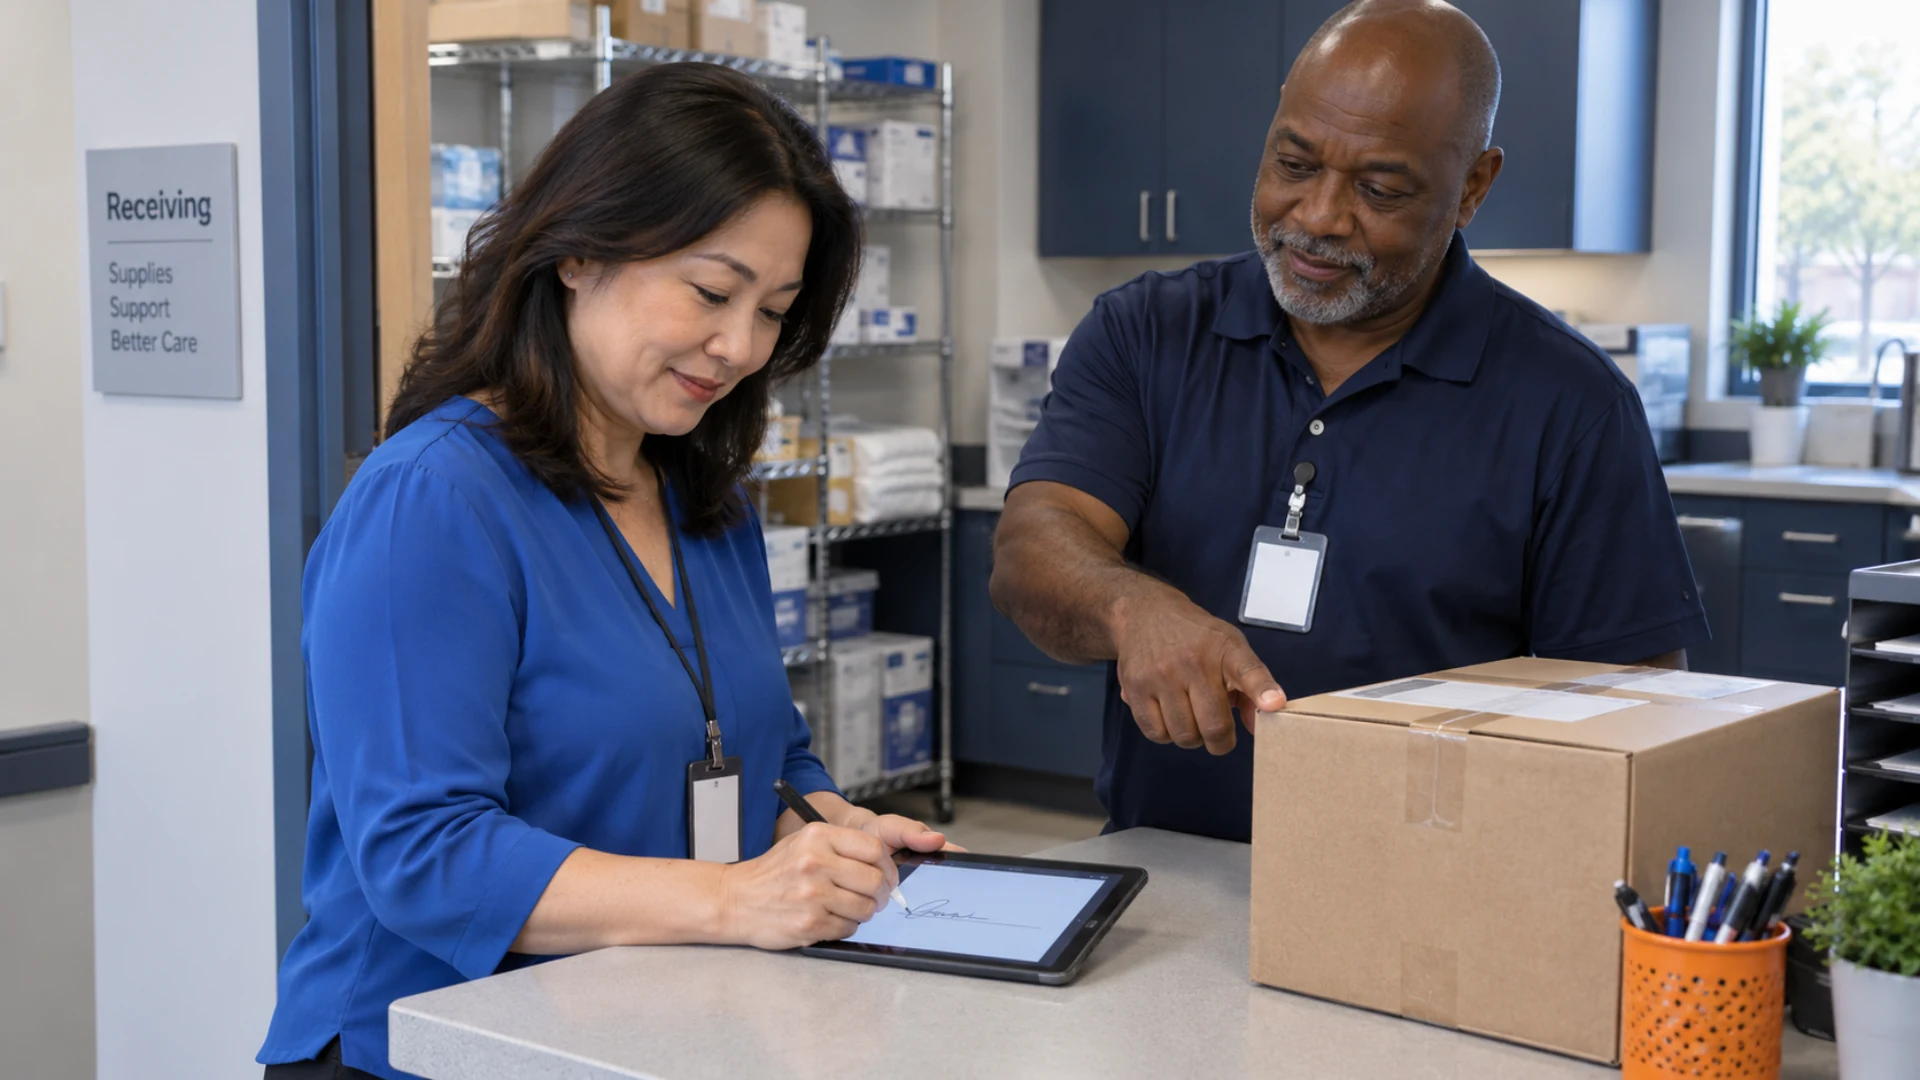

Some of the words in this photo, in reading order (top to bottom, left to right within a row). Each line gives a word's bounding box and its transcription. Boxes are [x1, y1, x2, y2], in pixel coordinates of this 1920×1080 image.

[107, 189, 212, 226] Receiving
[109, 261, 173, 289] Supplies
[110, 295, 171, 323] Support
[111, 329, 157, 352] Better
[162, 330, 198, 354] Care
